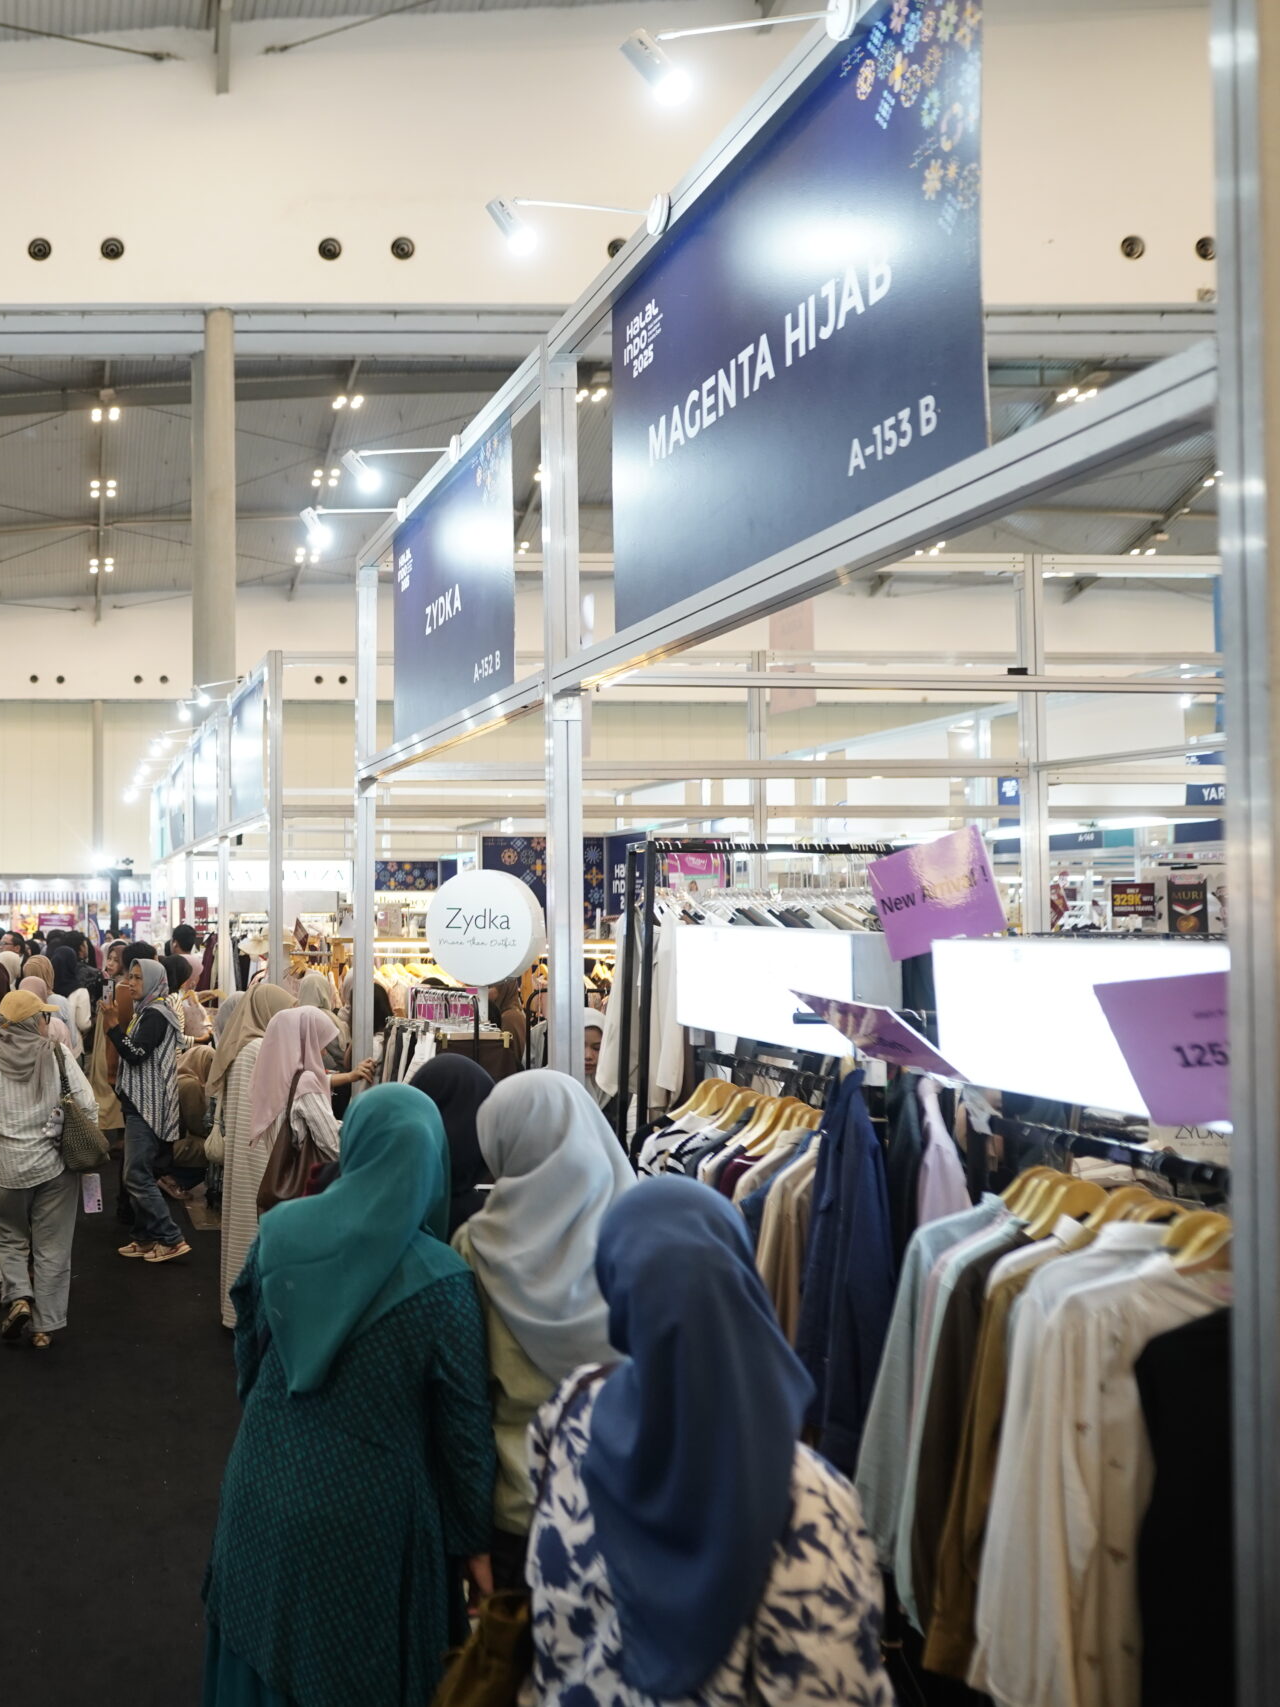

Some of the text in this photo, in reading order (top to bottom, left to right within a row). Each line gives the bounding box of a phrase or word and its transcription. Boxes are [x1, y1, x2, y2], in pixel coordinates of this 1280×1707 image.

[632, 343, 654, 379] 2025
[648, 252, 893, 467] MAGENTA HIJAB
[847, 394, 938, 478] A-153 B
[425, 583, 463, 636] ZYDKA
[473, 650, 502, 684] A-152 B
[880, 892, 917, 915] New
[1113, 894, 1142, 906] 329K
[445, 907, 511, 936] Zydka
